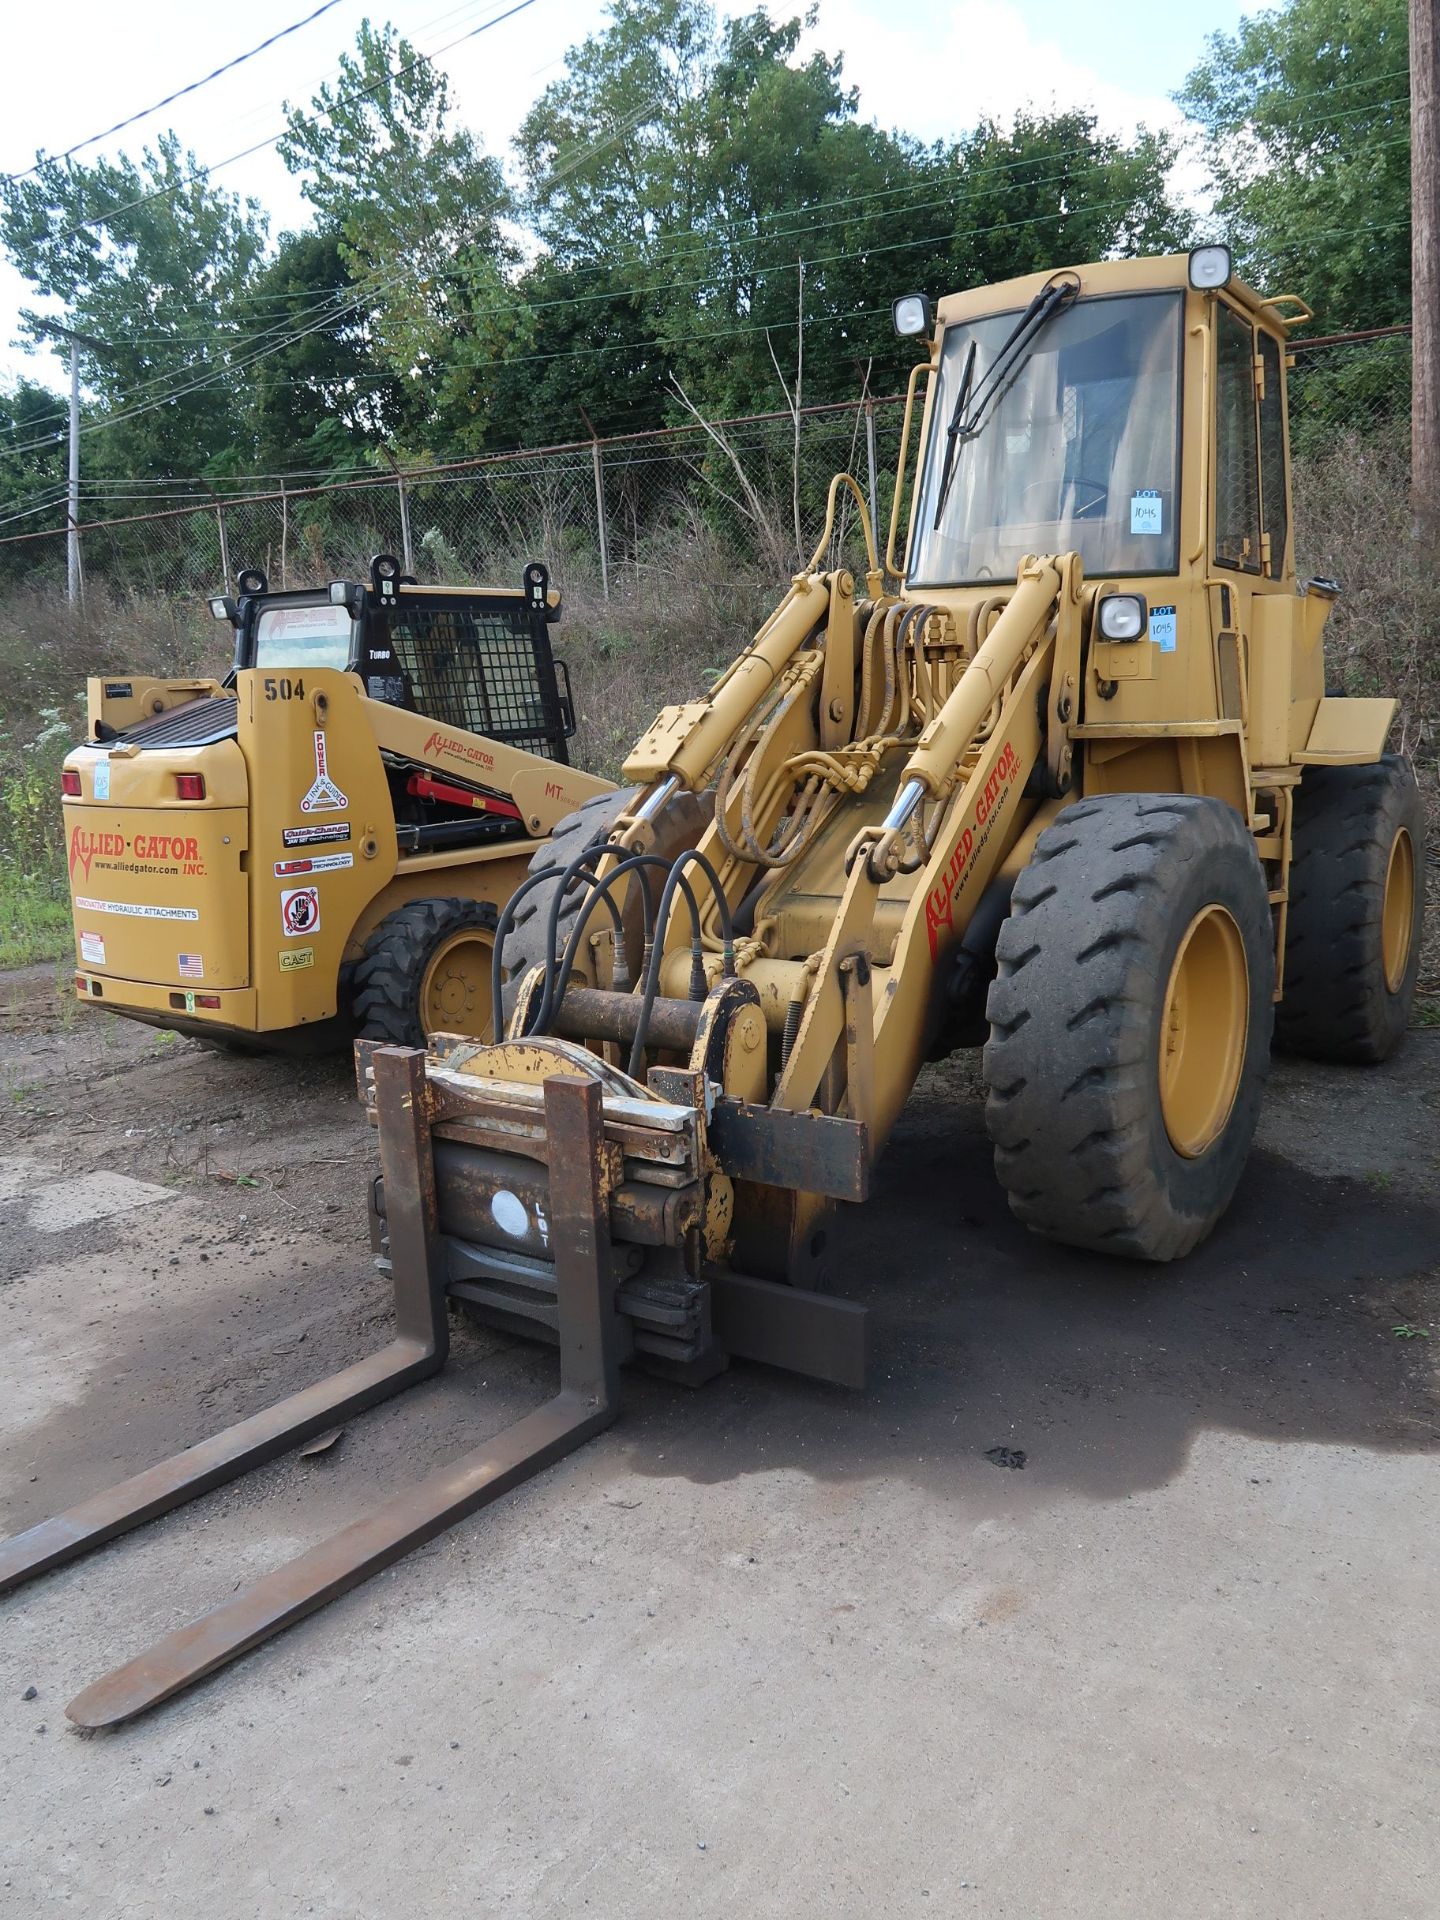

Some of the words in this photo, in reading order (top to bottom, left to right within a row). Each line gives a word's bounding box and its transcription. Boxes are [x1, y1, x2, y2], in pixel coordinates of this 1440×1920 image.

[1135, 490, 1158, 498] LOT
[1153, 606, 1173, 616] LOT
[264, 678, 305, 701] 504
[316, 733, 326, 776] POWER
[306, 781, 321, 802] LINK
[325, 782, 343, 801] GUIDE
[545, 781, 564, 801] MT
[95, 861, 179, 875] www.alliedgator.com
[182, 863, 208, 875] INC.
[313, 860, 351, 869] TECHNOLOGY
[107, 903, 143, 915] HYDRAULIC
[143, 907, 197, 919] ATTACHMENTS
[285, 906, 307, 934] HANDS
[281, 951, 313, 967] CAST
